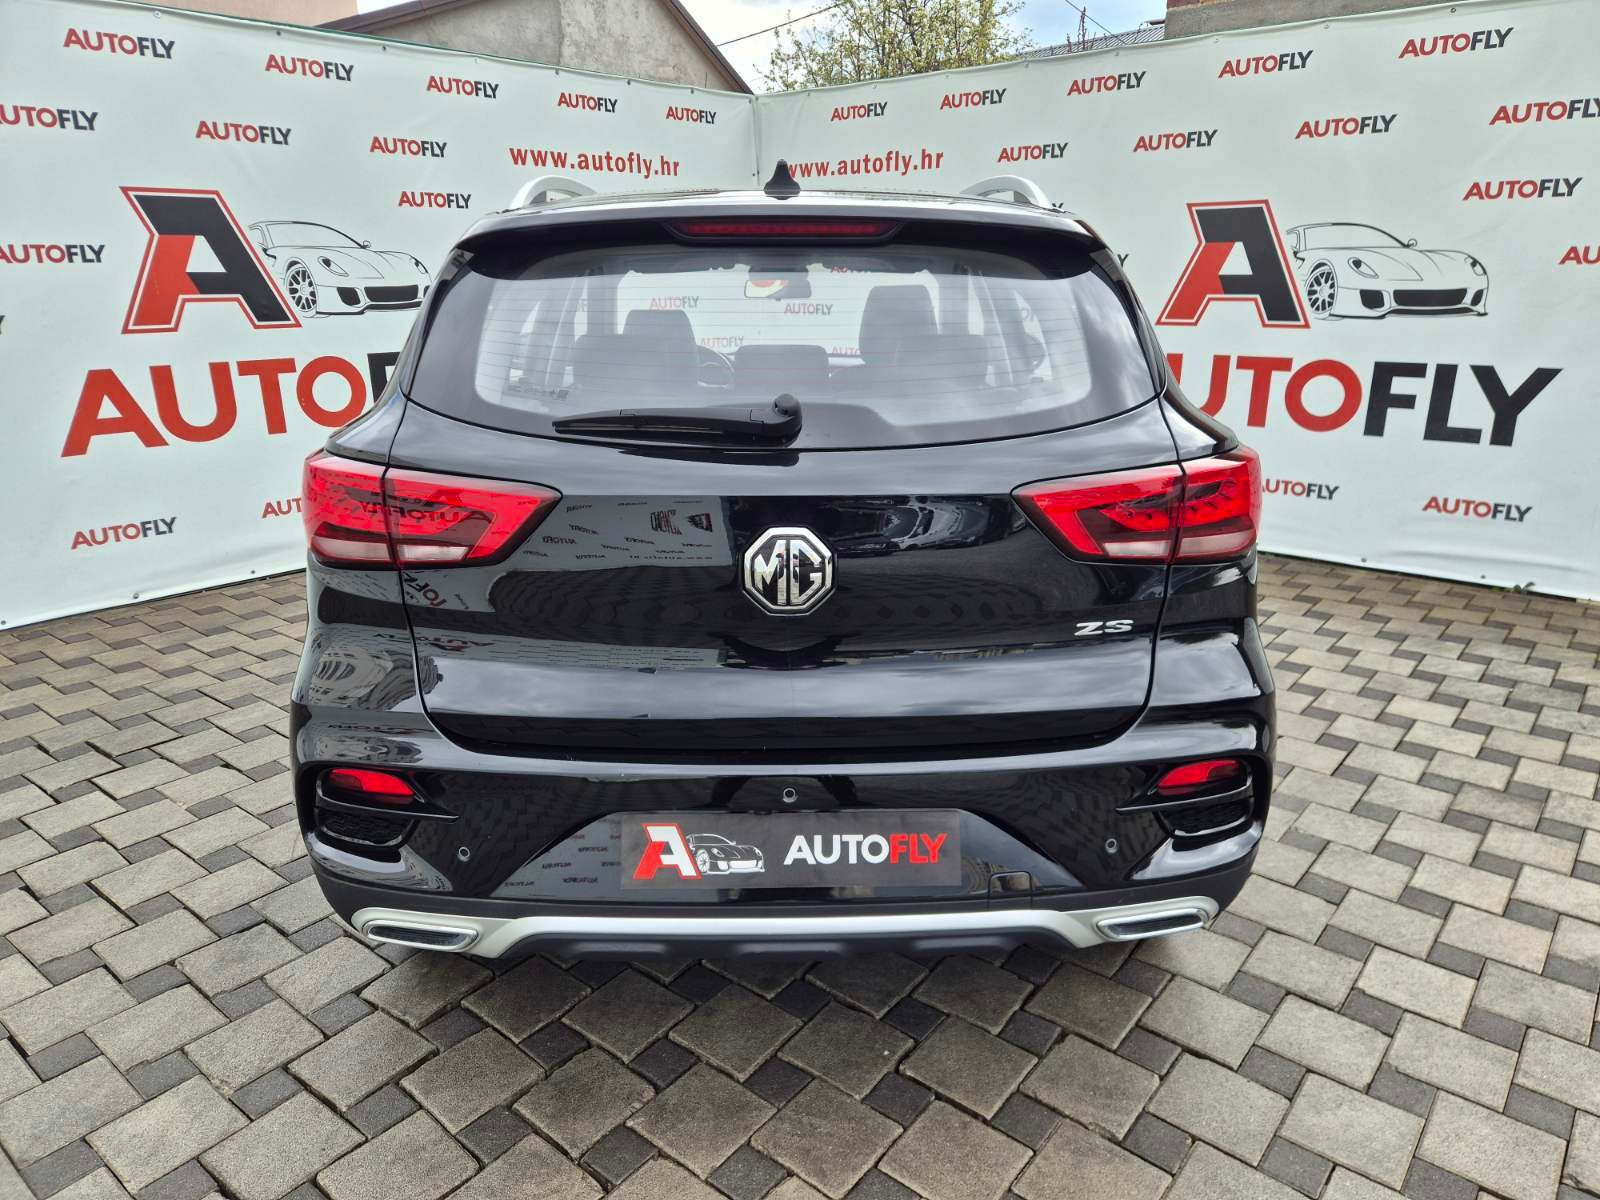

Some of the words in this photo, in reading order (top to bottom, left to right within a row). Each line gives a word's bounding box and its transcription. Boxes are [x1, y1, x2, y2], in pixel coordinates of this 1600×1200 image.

[64, 28, 175, 59] AUTOFLY
[1399, 27, 1513, 59] AUTOFLY
[265, 54, 354, 81] AUTOFLY
[1218, 50, 1313, 78] AUTOFLY
[427, 76, 499, 99] AUTOFLY
[1067, 71, 1146, 96] AUTOFLY
[558, 92, 617, 113] AUTOFLY
[831, 102, 887, 121] AUTOFLY
[940, 88, 1006, 110] AUTOFLY
[0, 104, 98, 131] UTOFLY
[666, 106, 716, 124] AUTOFLY
[1295, 114, 1397, 139] AUTOFLY
[196, 121, 291, 145] AUTOFLY
[1133, 130, 1217, 152] AUTOFLY
[370, 136, 447, 158] AUTOFLY
[998, 143, 1068, 162] AUTOFLY
[509, 148, 679, 179] www.autofly.hr
[398, 191, 471, 209] AUTOFLY
[1463, 177, 1582, 200] AUTOFLY
[61, 352, 400, 458] AUTOF
[1166, 352, 1563, 447] UTOFLY
[1263, 479, 1339, 500] UTOFLY
[1423, 496, 1532, 522] AUTOFLY
[71, 517, 176, 549] AUTOFLY
[752, 536, 826, 607] MG
[1074, 619, 1134, 636] ZS
[783, 832, 948, 865] AUTOFLY
